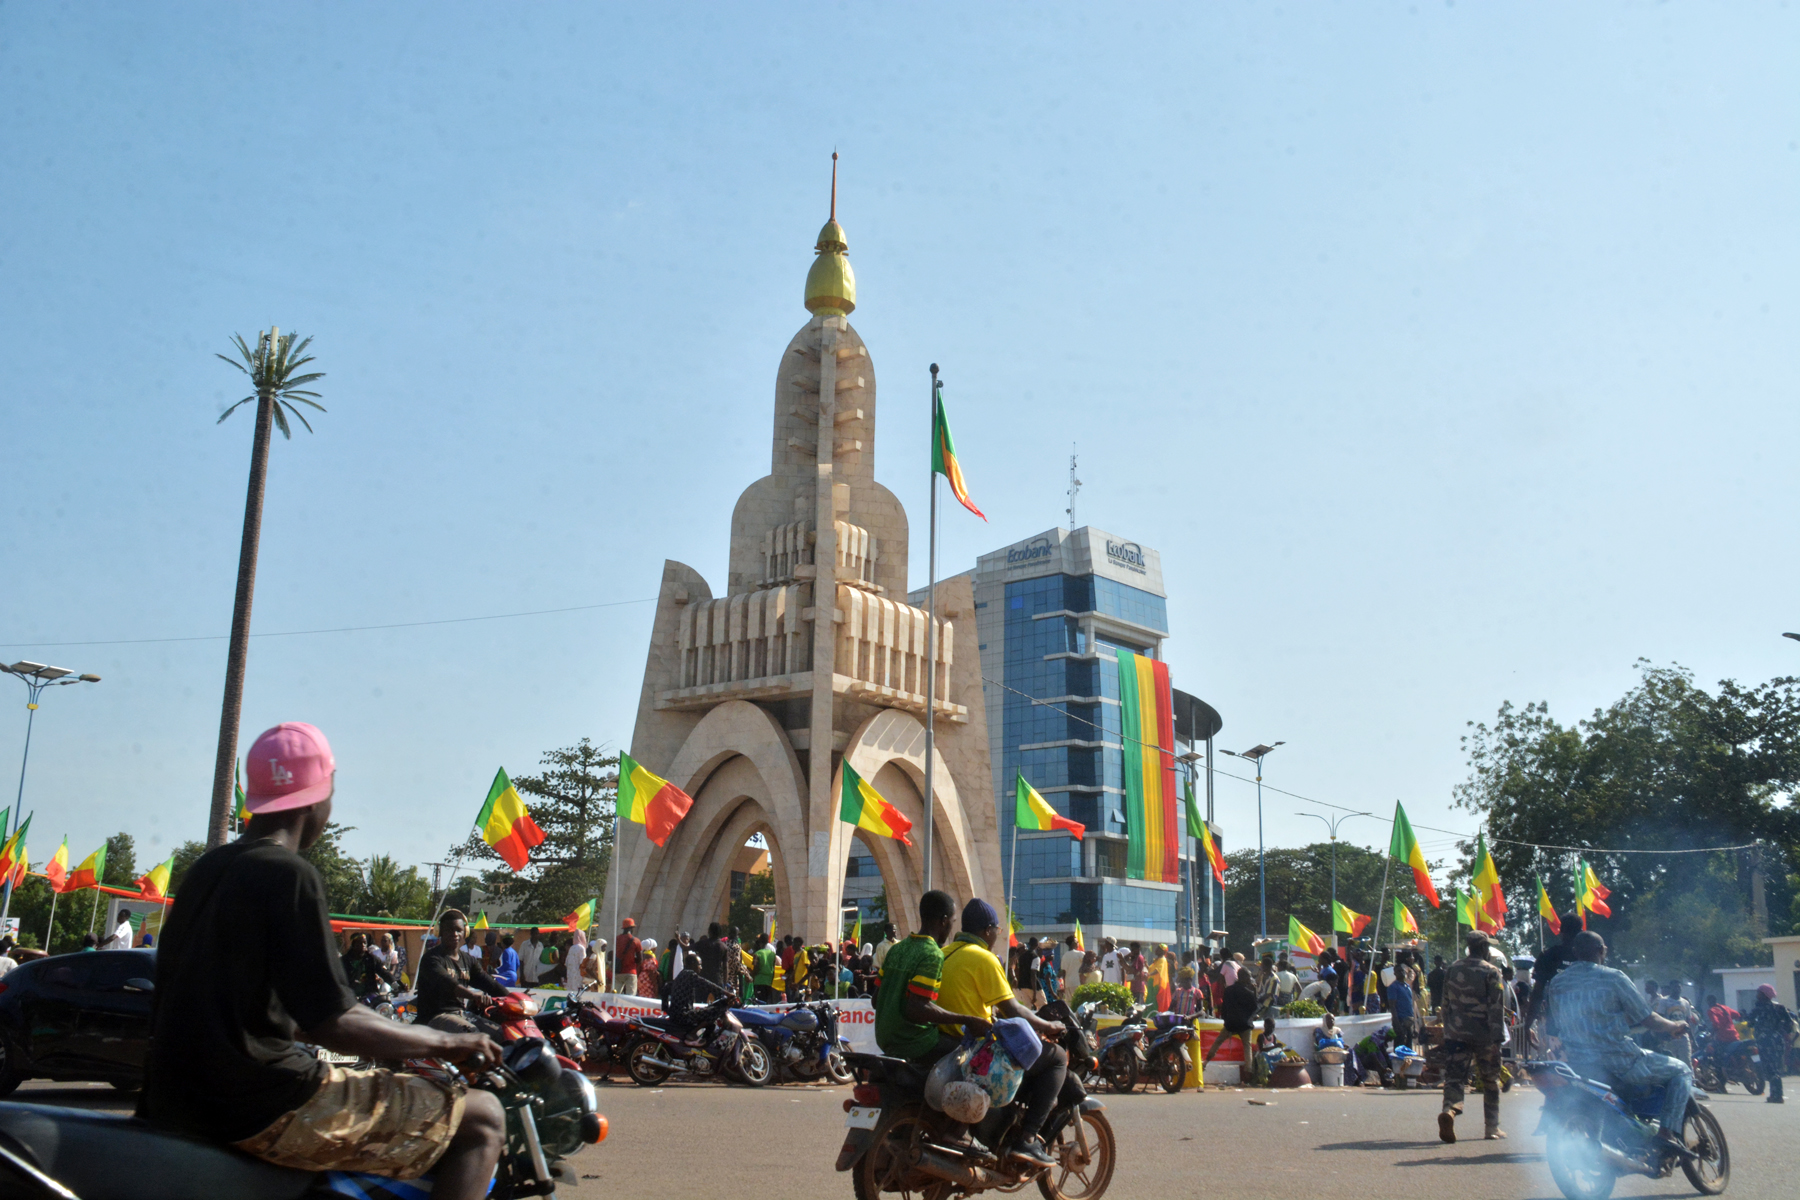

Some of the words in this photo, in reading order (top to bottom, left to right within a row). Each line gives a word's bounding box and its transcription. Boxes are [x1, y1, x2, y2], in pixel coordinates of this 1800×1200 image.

[1007, 538, 1052, 563] Ecobank
[1106, 539, 1145, 567] Ecobank
[268, 758, 294, 786] LA
